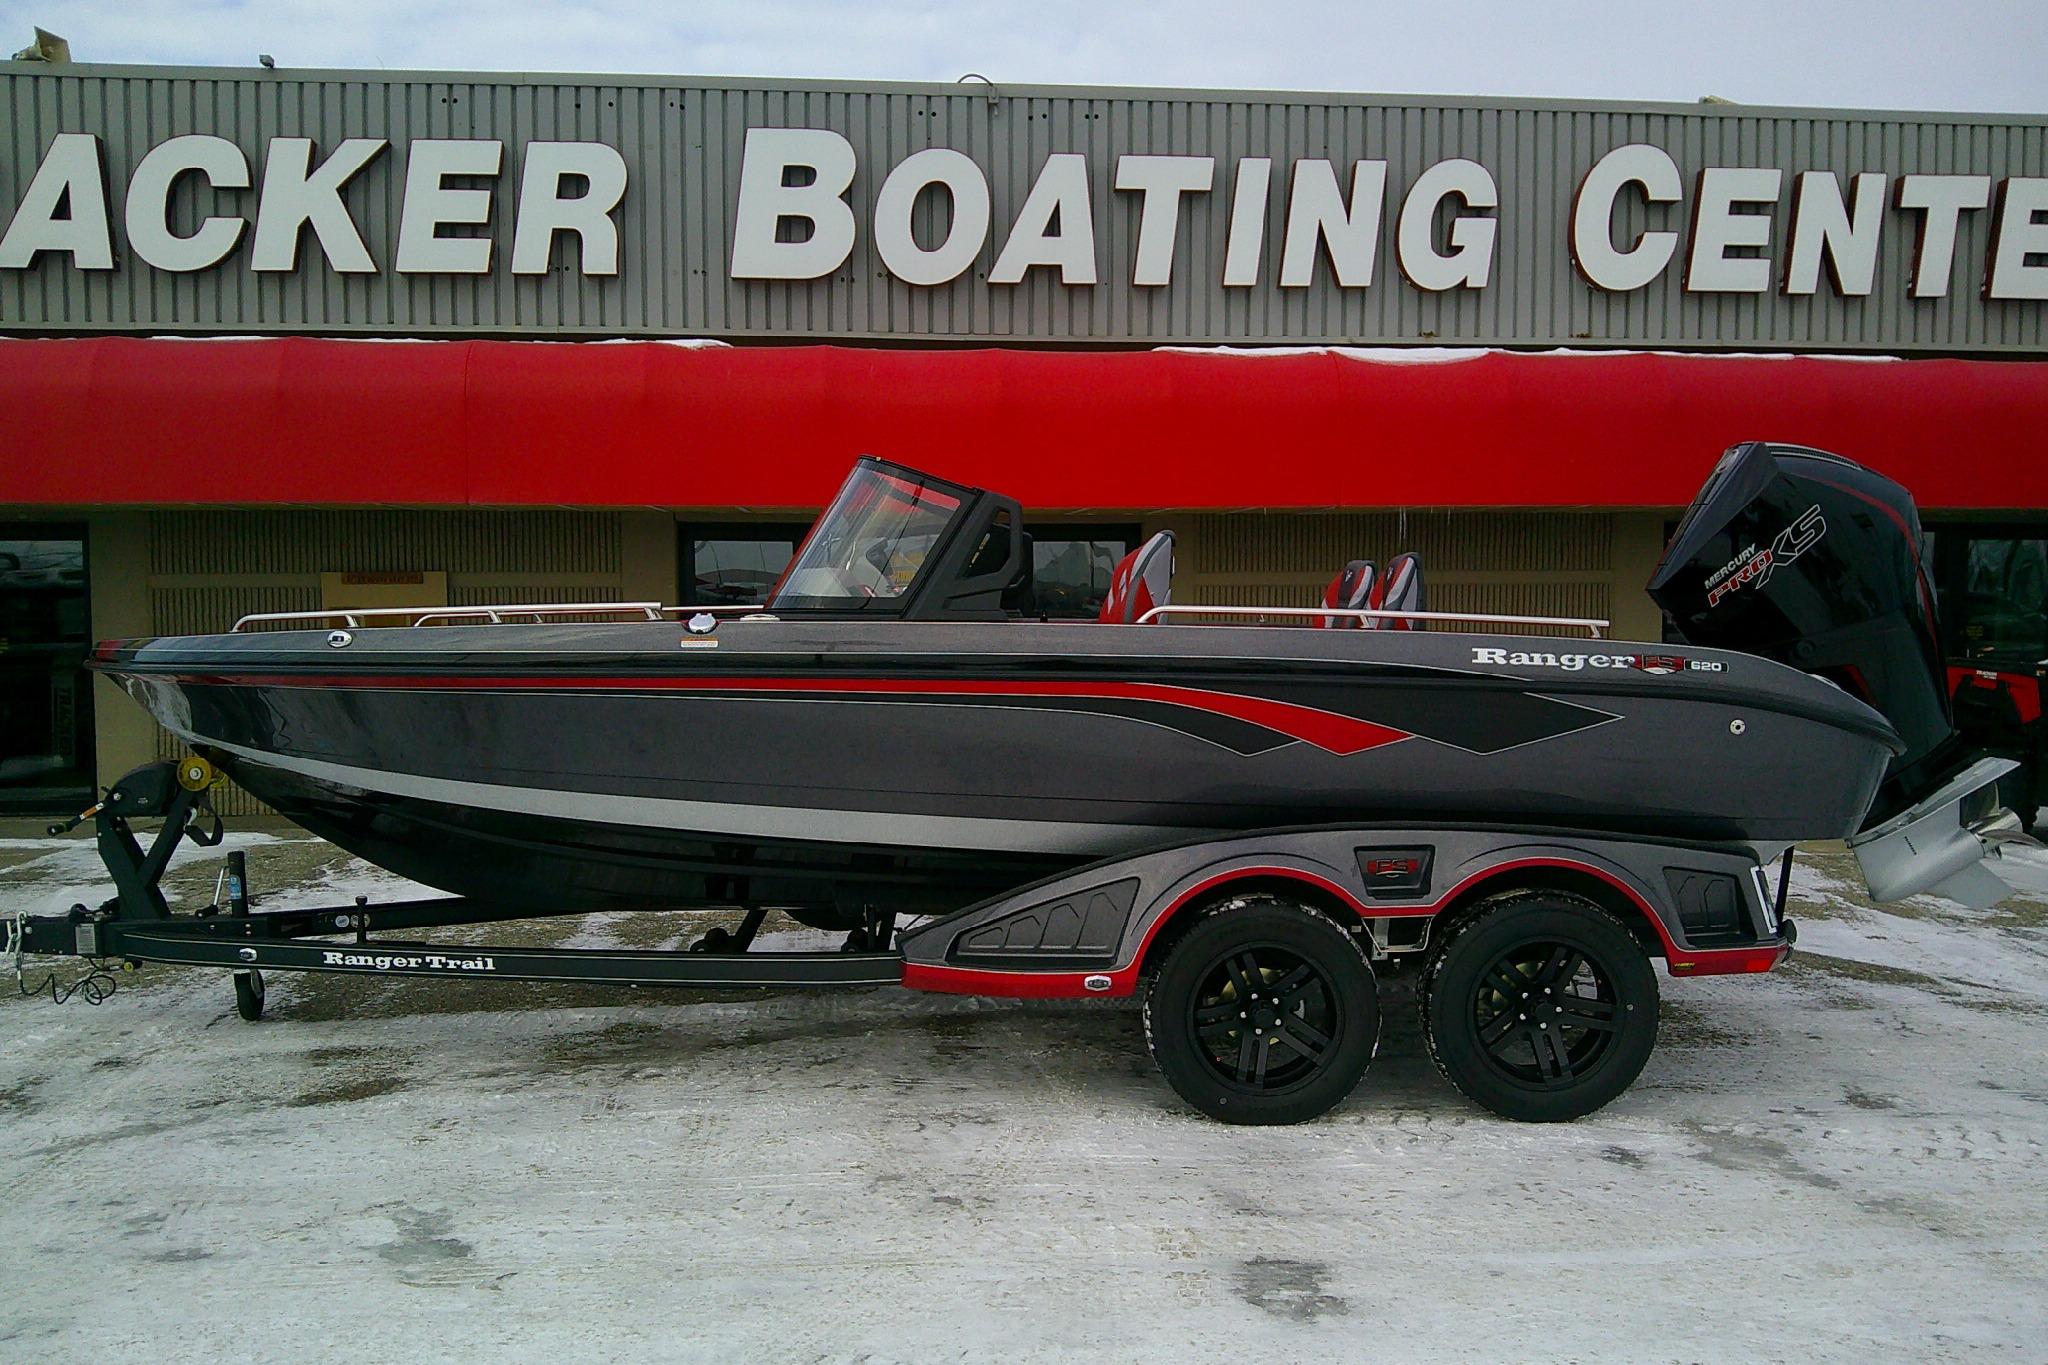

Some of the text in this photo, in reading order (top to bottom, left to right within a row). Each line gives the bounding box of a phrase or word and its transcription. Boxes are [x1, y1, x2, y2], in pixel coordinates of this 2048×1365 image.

[0, 132, 628, 276] ACKER
[731, 127, 1498, 291] BOATING
[1704, 543, 1756, 590] MERCURY
[1708, 549, 1773, 608] PRO
[1471, 647, 1636, 671] Ranger
[1690, 661, 1723, 672] 620
[322, 951, 496, 971] Ranger Trail
